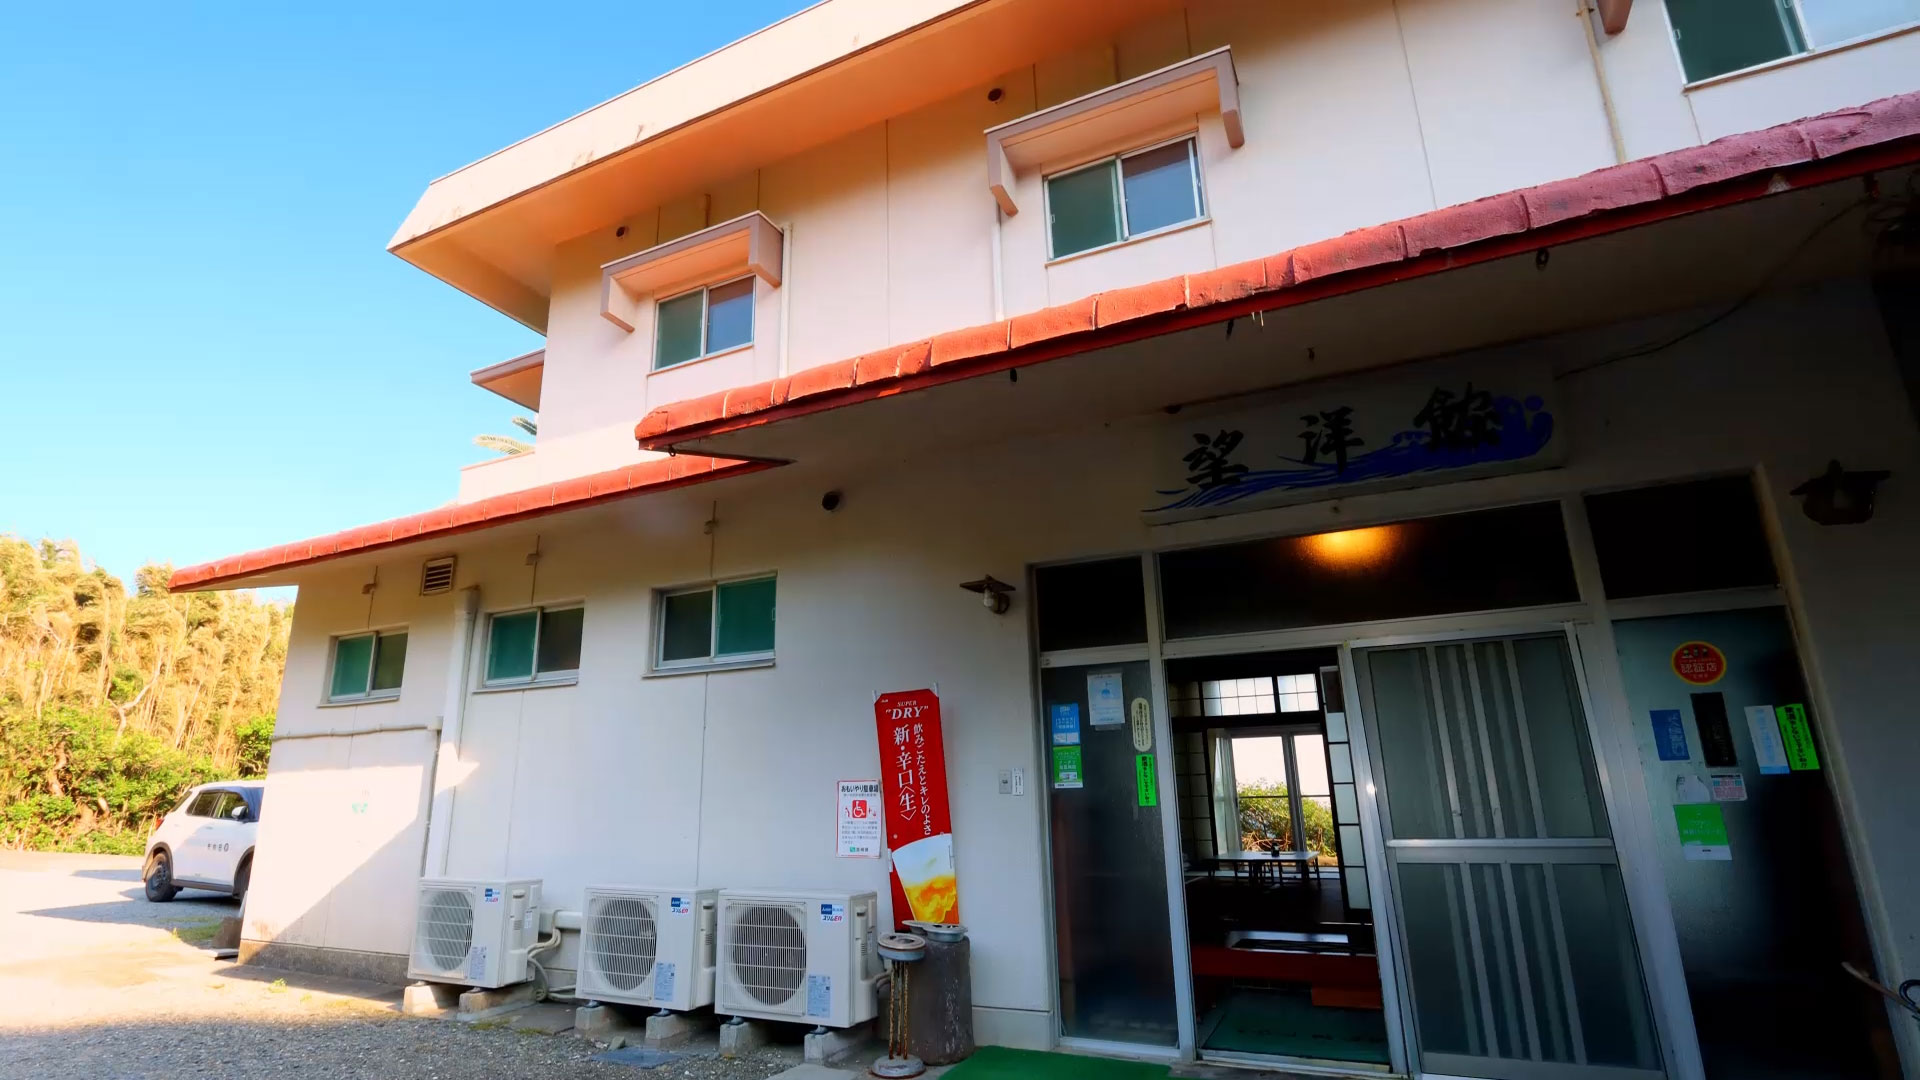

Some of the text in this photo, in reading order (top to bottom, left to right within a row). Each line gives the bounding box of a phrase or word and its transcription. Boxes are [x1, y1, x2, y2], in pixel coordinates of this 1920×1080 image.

[913, 723, 932, 836] 飲みごたえとキレのよさ
